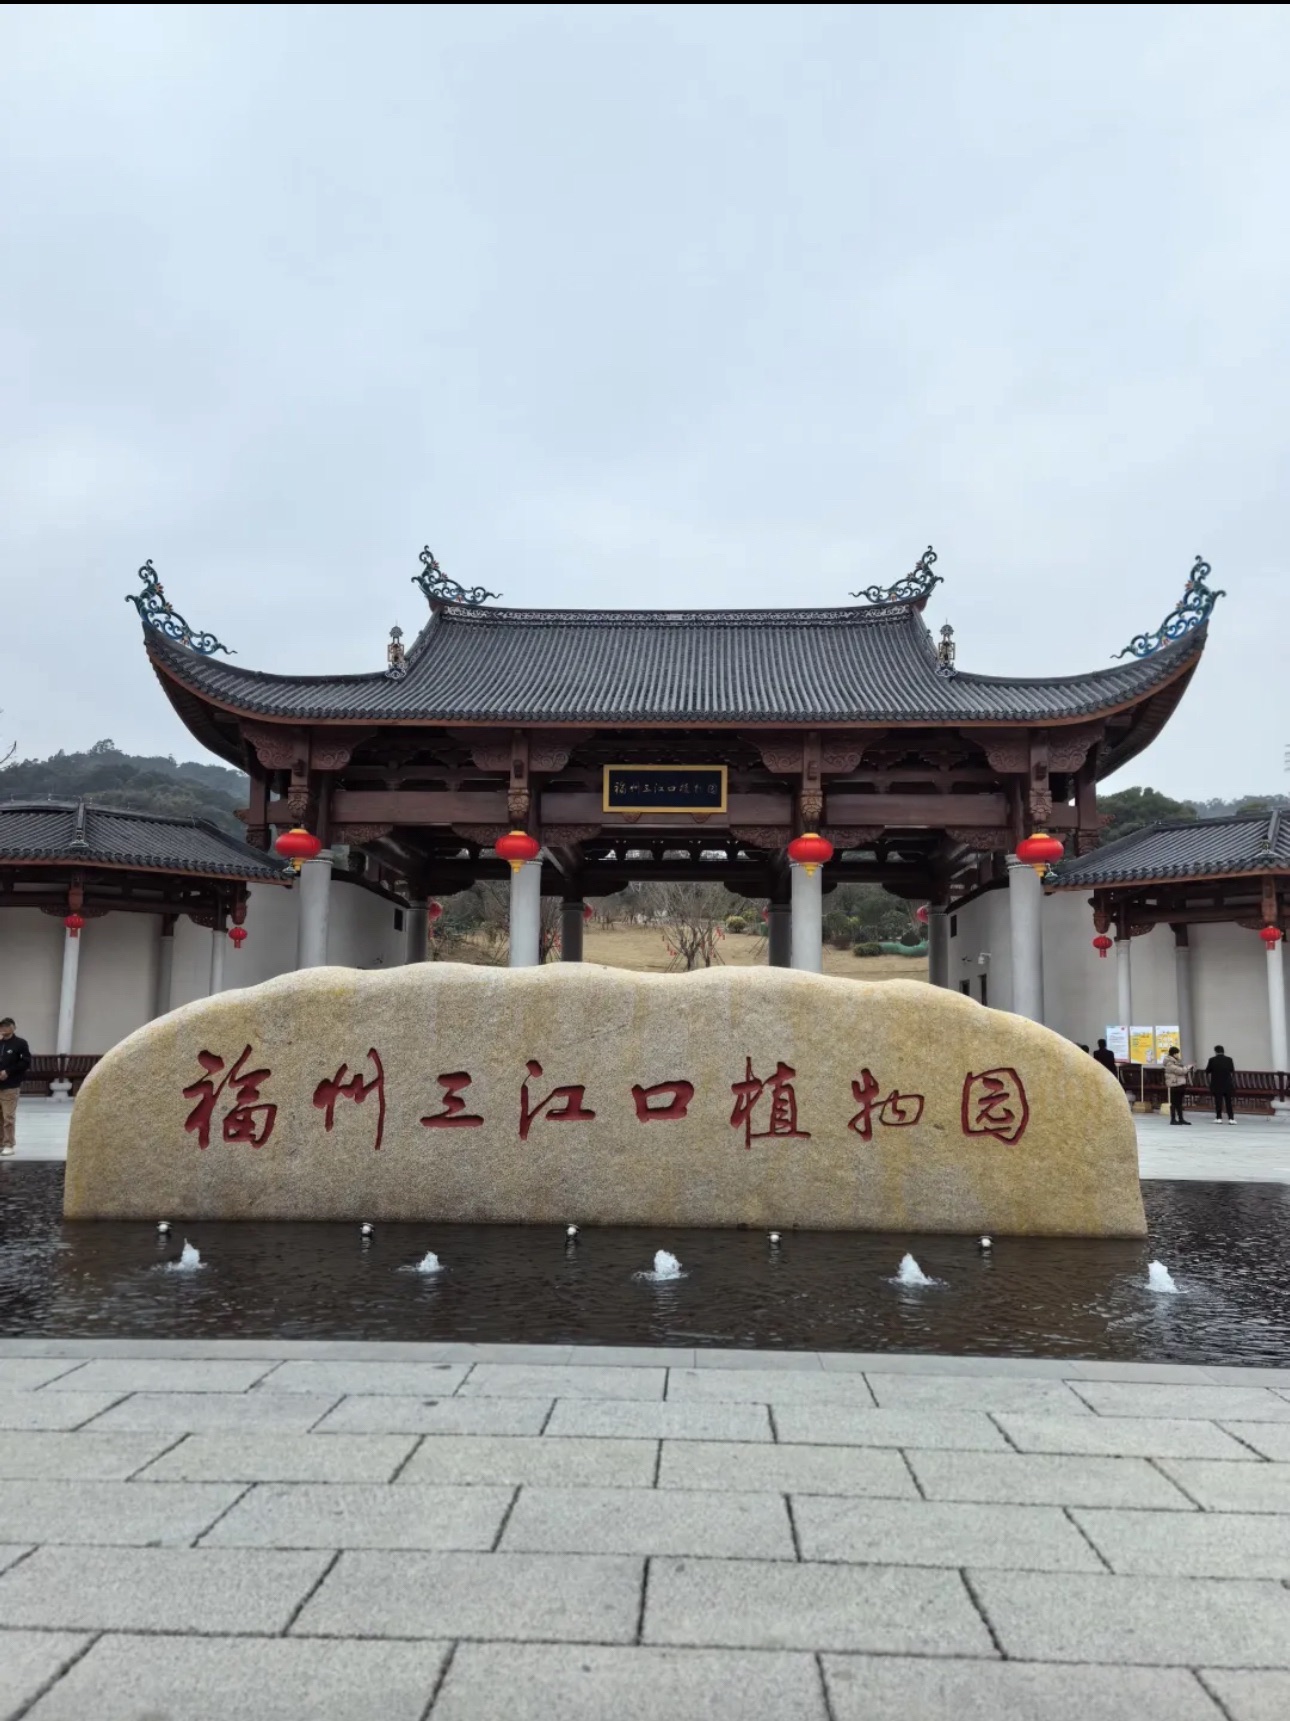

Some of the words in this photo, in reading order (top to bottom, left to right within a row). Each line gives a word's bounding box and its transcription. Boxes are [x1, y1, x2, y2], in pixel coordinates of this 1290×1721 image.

[182, 1044, 1030, 1150] 福州三江口植物园
